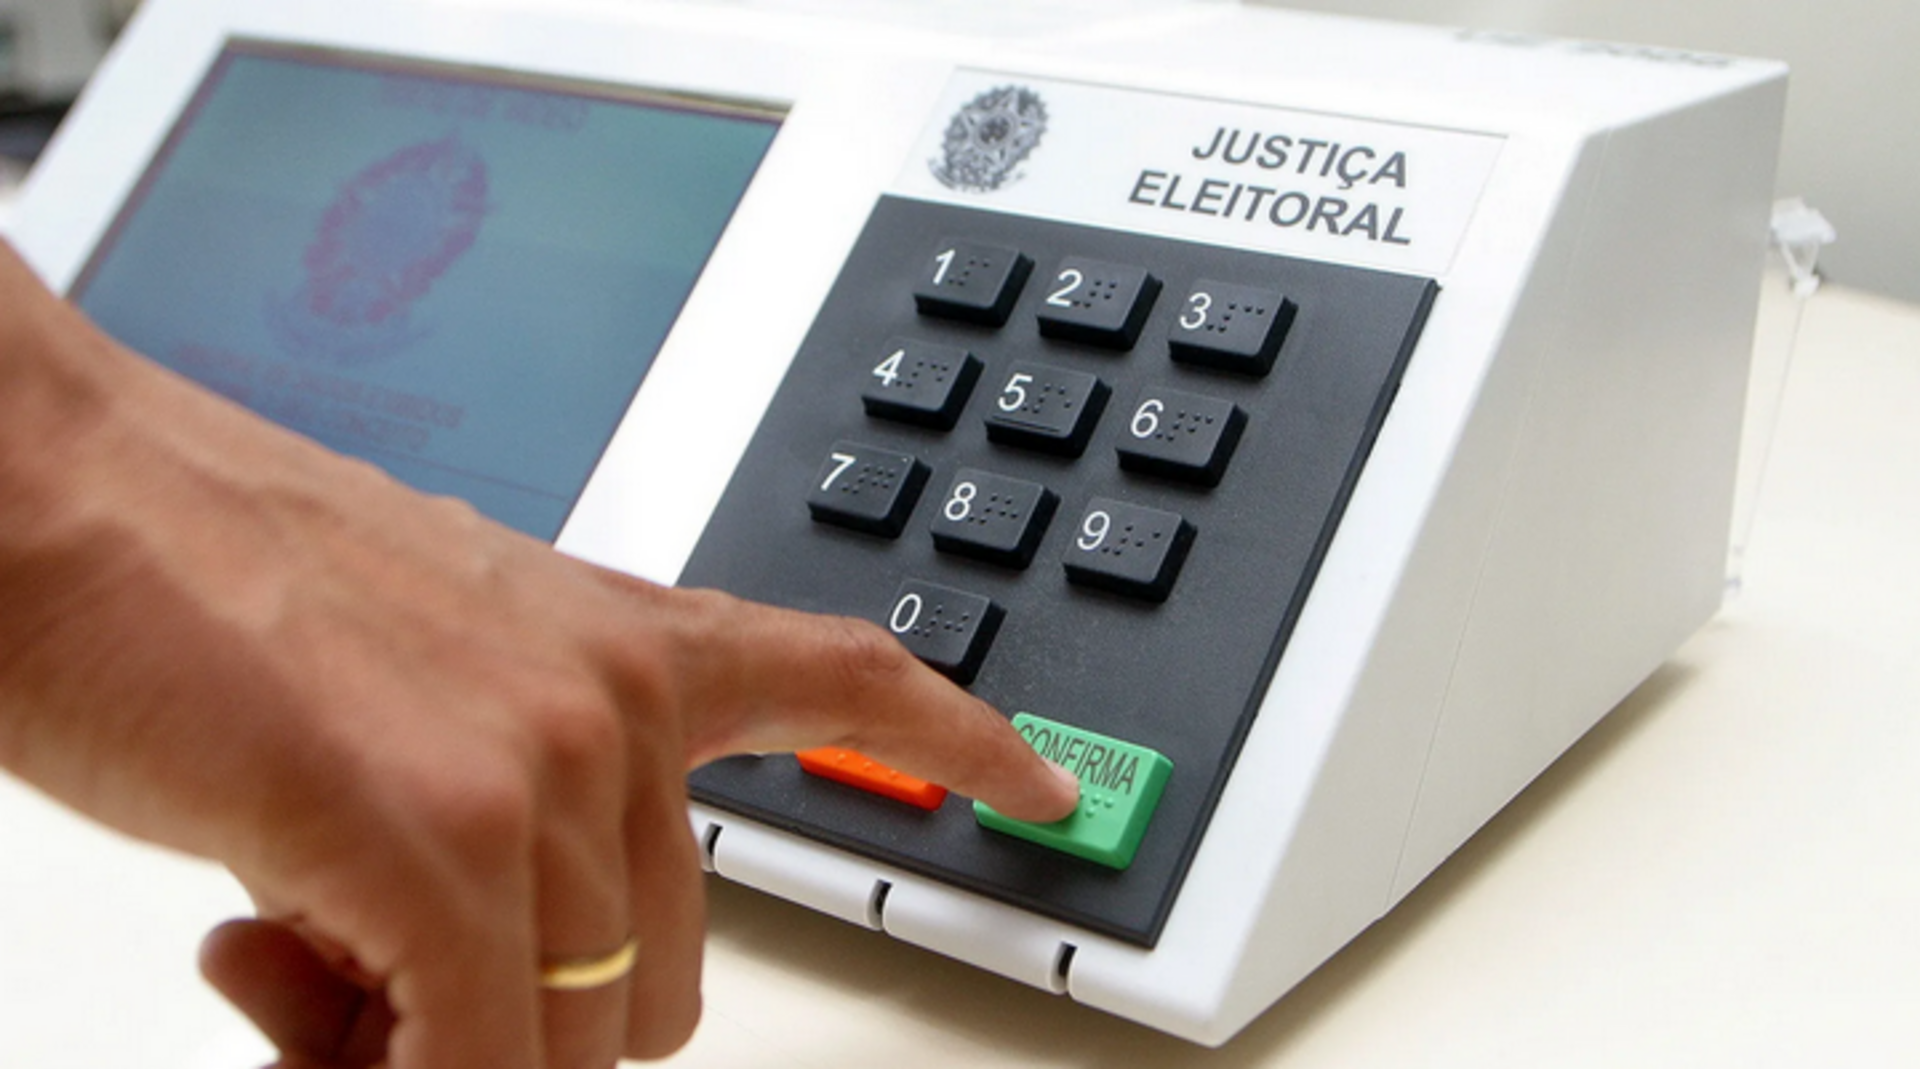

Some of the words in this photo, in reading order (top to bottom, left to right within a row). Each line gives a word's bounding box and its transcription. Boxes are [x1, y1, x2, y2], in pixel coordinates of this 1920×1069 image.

[1191, 127, 1406, 190] JUSTIÇA
[1128, 169, 1411, 246] ELEITORAL
[932, 249, 956, 285] 1
[1045, 268, 1084, 308] 2
[1179, 291, 1213, 330] 3
[872, 349, 905, 387] 4
[997, 372, 1034, 412] 5
[1130, 398, 1165, 438] 6
[820, 452, 856, 491] 7
[943, 481, 977, 521] 8
[1076, 510, 1111, 551] 9
[889, 593, 922, 633] 0
